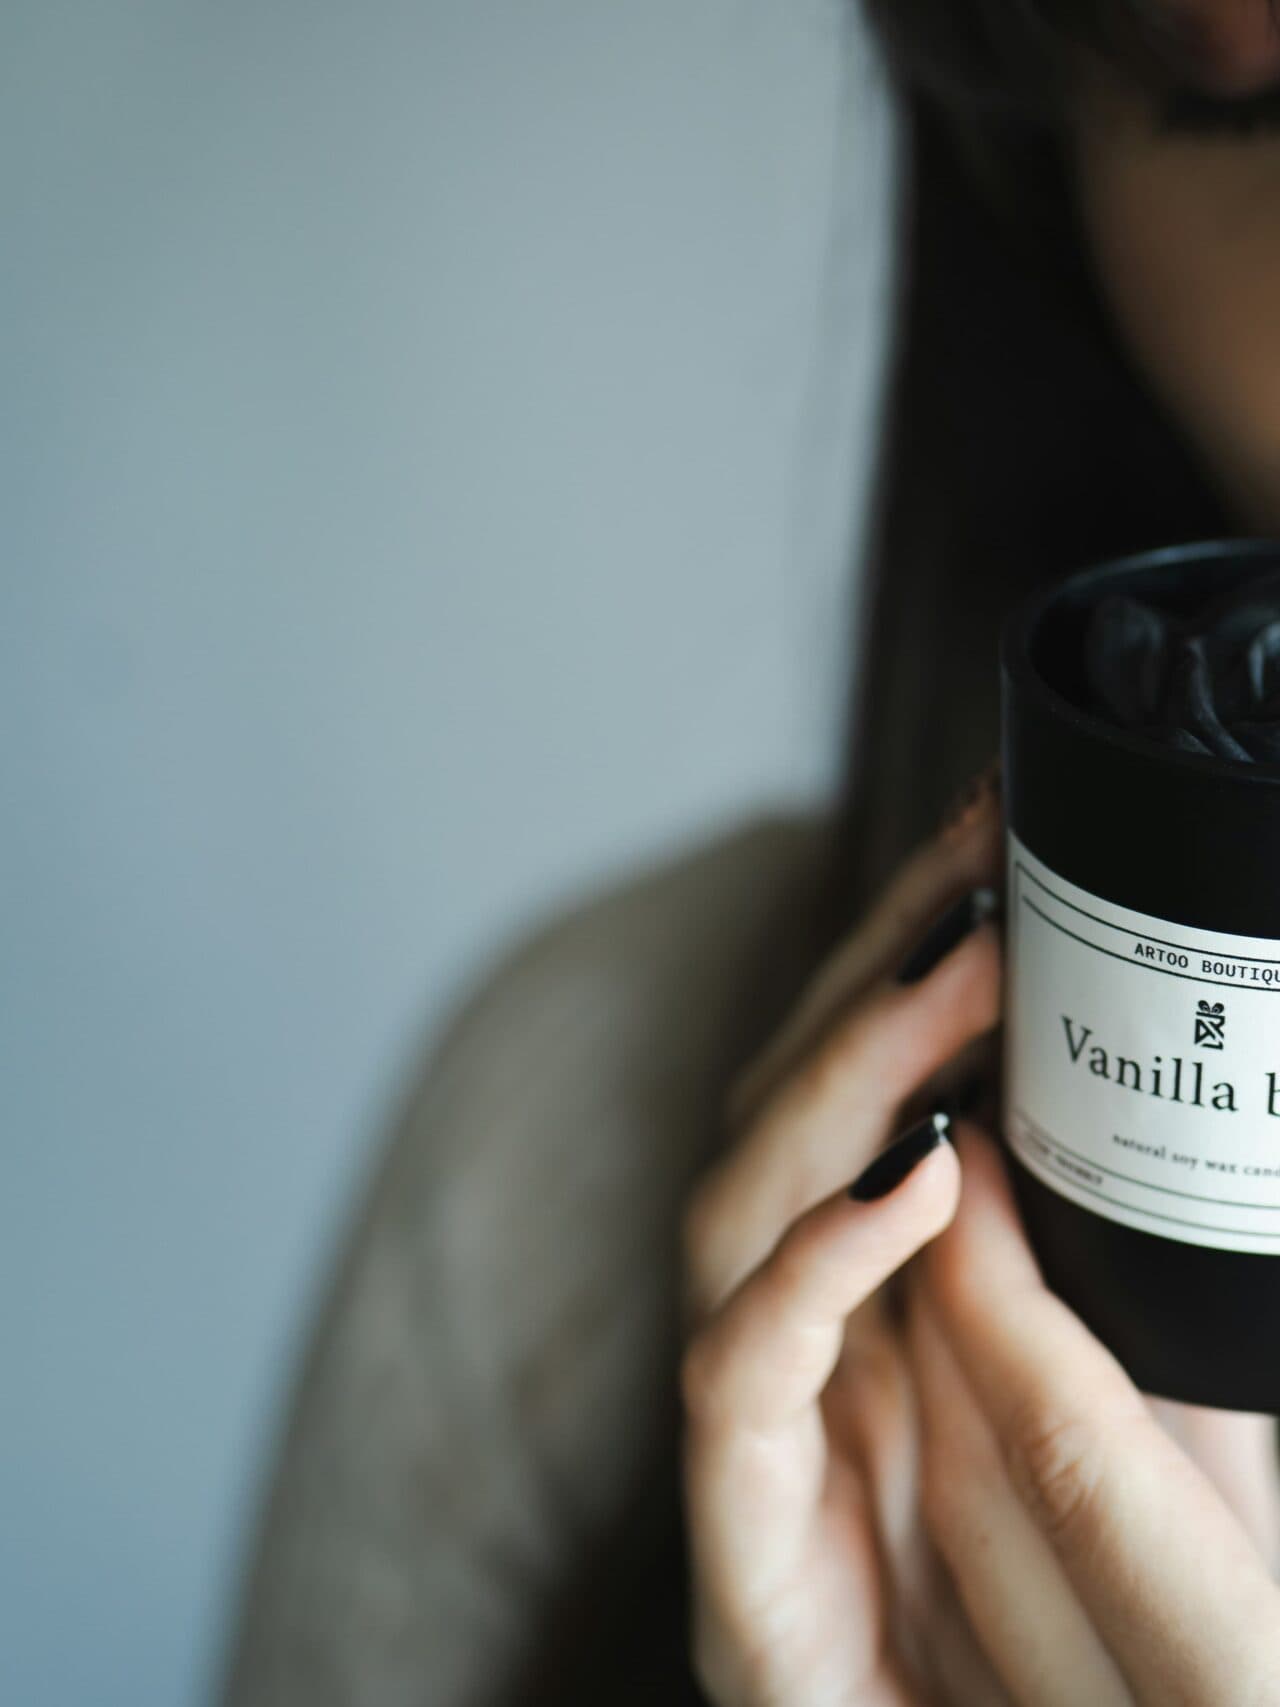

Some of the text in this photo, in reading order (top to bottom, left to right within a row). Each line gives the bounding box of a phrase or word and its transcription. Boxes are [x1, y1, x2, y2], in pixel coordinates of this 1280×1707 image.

[1134, 943, 1189, 968] ARTOO
[1061, 1015, 1239, 1113] Vanilla
[1113, 1133, 1166, 1161] natural
[1172, 1151, 1199, 1169] soy
[1205, 1158, 1237, 1175] wax
